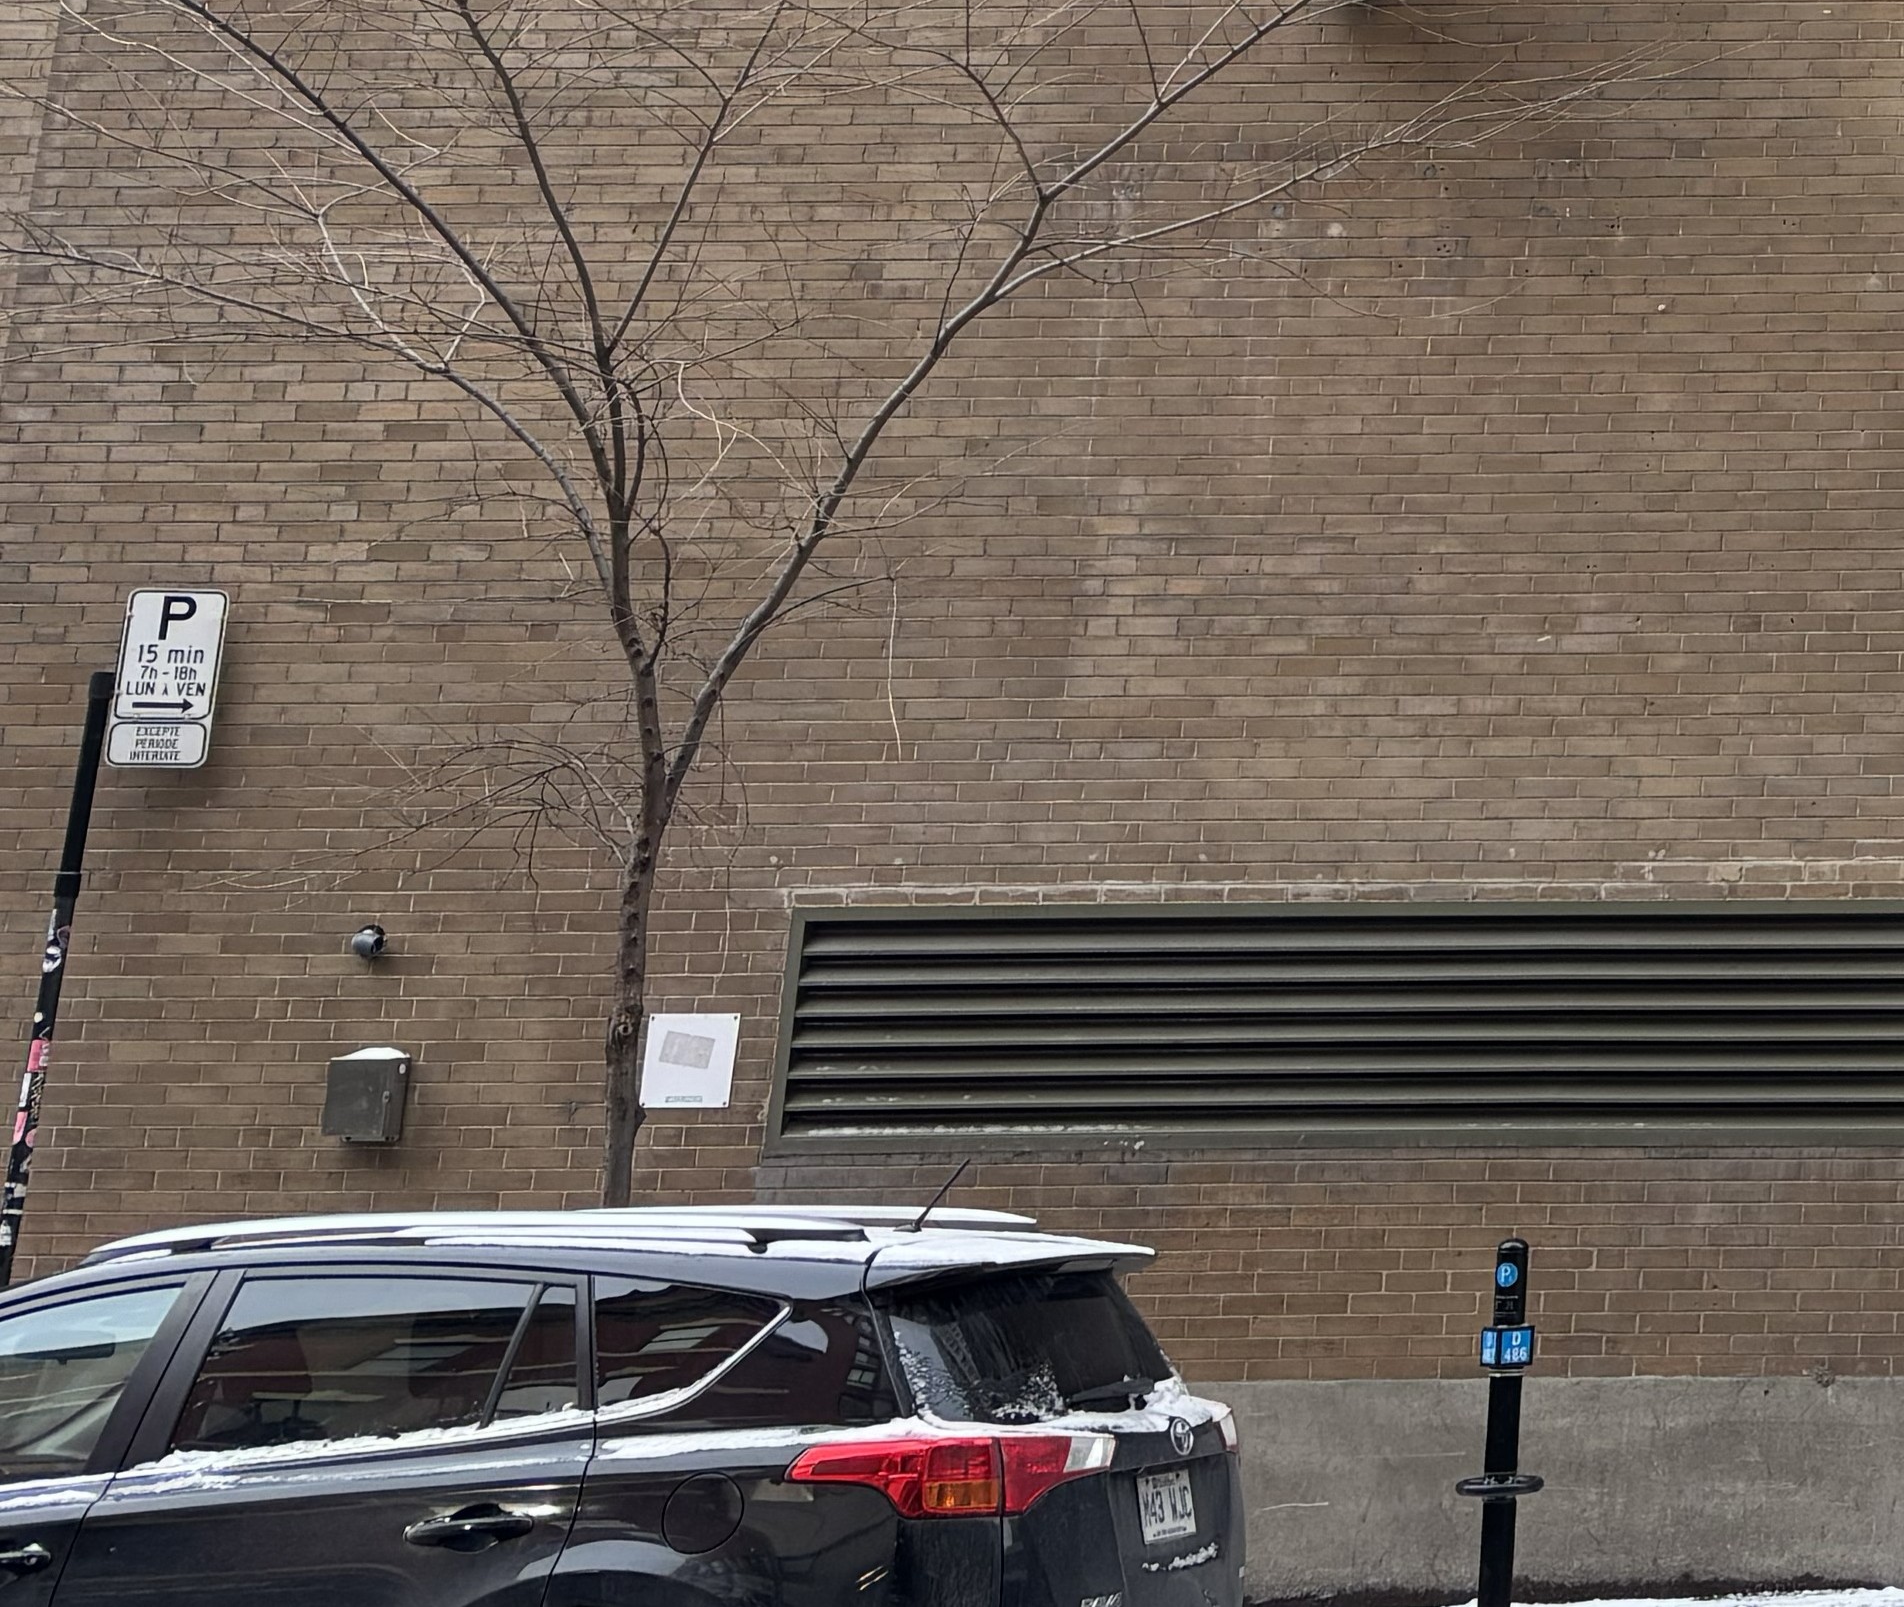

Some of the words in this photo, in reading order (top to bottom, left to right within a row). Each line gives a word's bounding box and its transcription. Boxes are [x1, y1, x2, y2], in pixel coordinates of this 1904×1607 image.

[158, 595, 197, 640] P
[137, 644, 159, 664] 15
[167, 645, 204, 664] min
[140, 665, 158, 680] 7h
[174, 666, 197, 681] 18h
[125, 681, 155, 696] LUN
[176, 682, 206, 696] VEN
